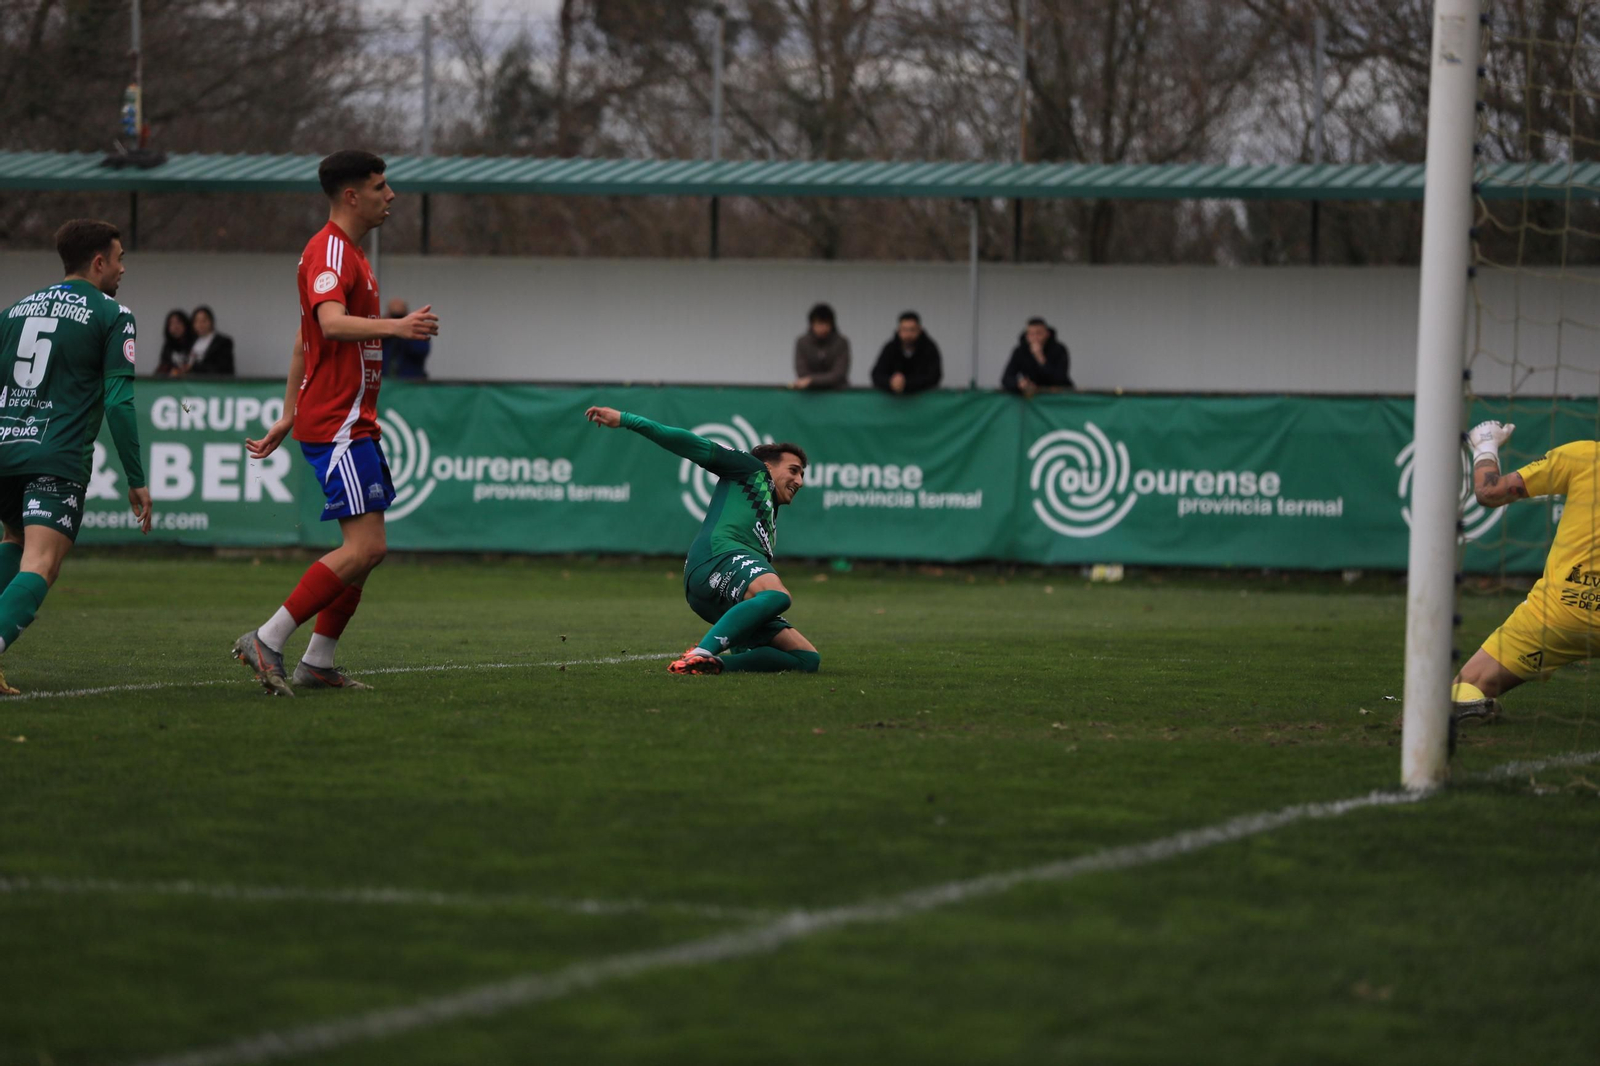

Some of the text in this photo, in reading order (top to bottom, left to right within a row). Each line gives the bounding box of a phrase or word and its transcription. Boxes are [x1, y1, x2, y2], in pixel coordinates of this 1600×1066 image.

[50, 301, 93, 325] BORGE
[13, 316, 59, 389] 5
[8, 398, 20, 407] DE
[10, 388, 37, 398] XUNTA
[151, 396, 285, 432] GRUPO
[149, 442, 294, 503] BER
[432, 455, 573, 484] ourense
[803, 461, 924, 490] urense
[1060, 468, 1101, 494] ou
[473, 482, 630, 502] provincia termal
[1133, 469, 1281, 497] ourense
[823, 489, 983, 510] provincia termal
[1178, 495, 1343, 517] provincia termal
[1578, 600, 1592, 611] DE
